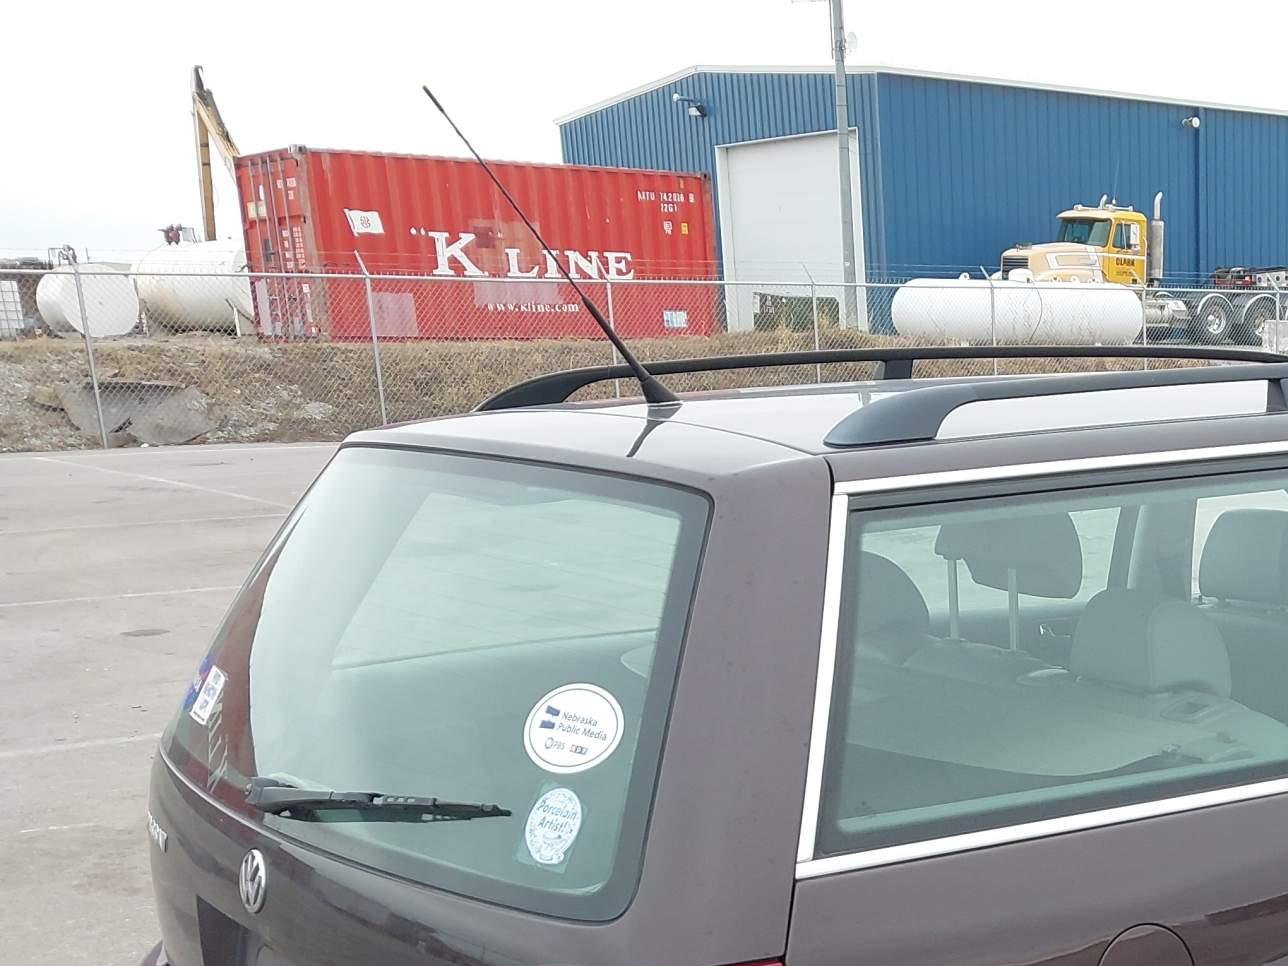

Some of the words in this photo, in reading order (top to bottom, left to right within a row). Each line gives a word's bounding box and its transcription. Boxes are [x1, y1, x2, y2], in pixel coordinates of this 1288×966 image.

[505, 248, 635, 281] LINE
[562, 711, 598, 727] Nebraska
[556, 722, 581, 736] Public
[582, 727, 608, 741] Media
[535, 799, 578, 820] Porcelain
